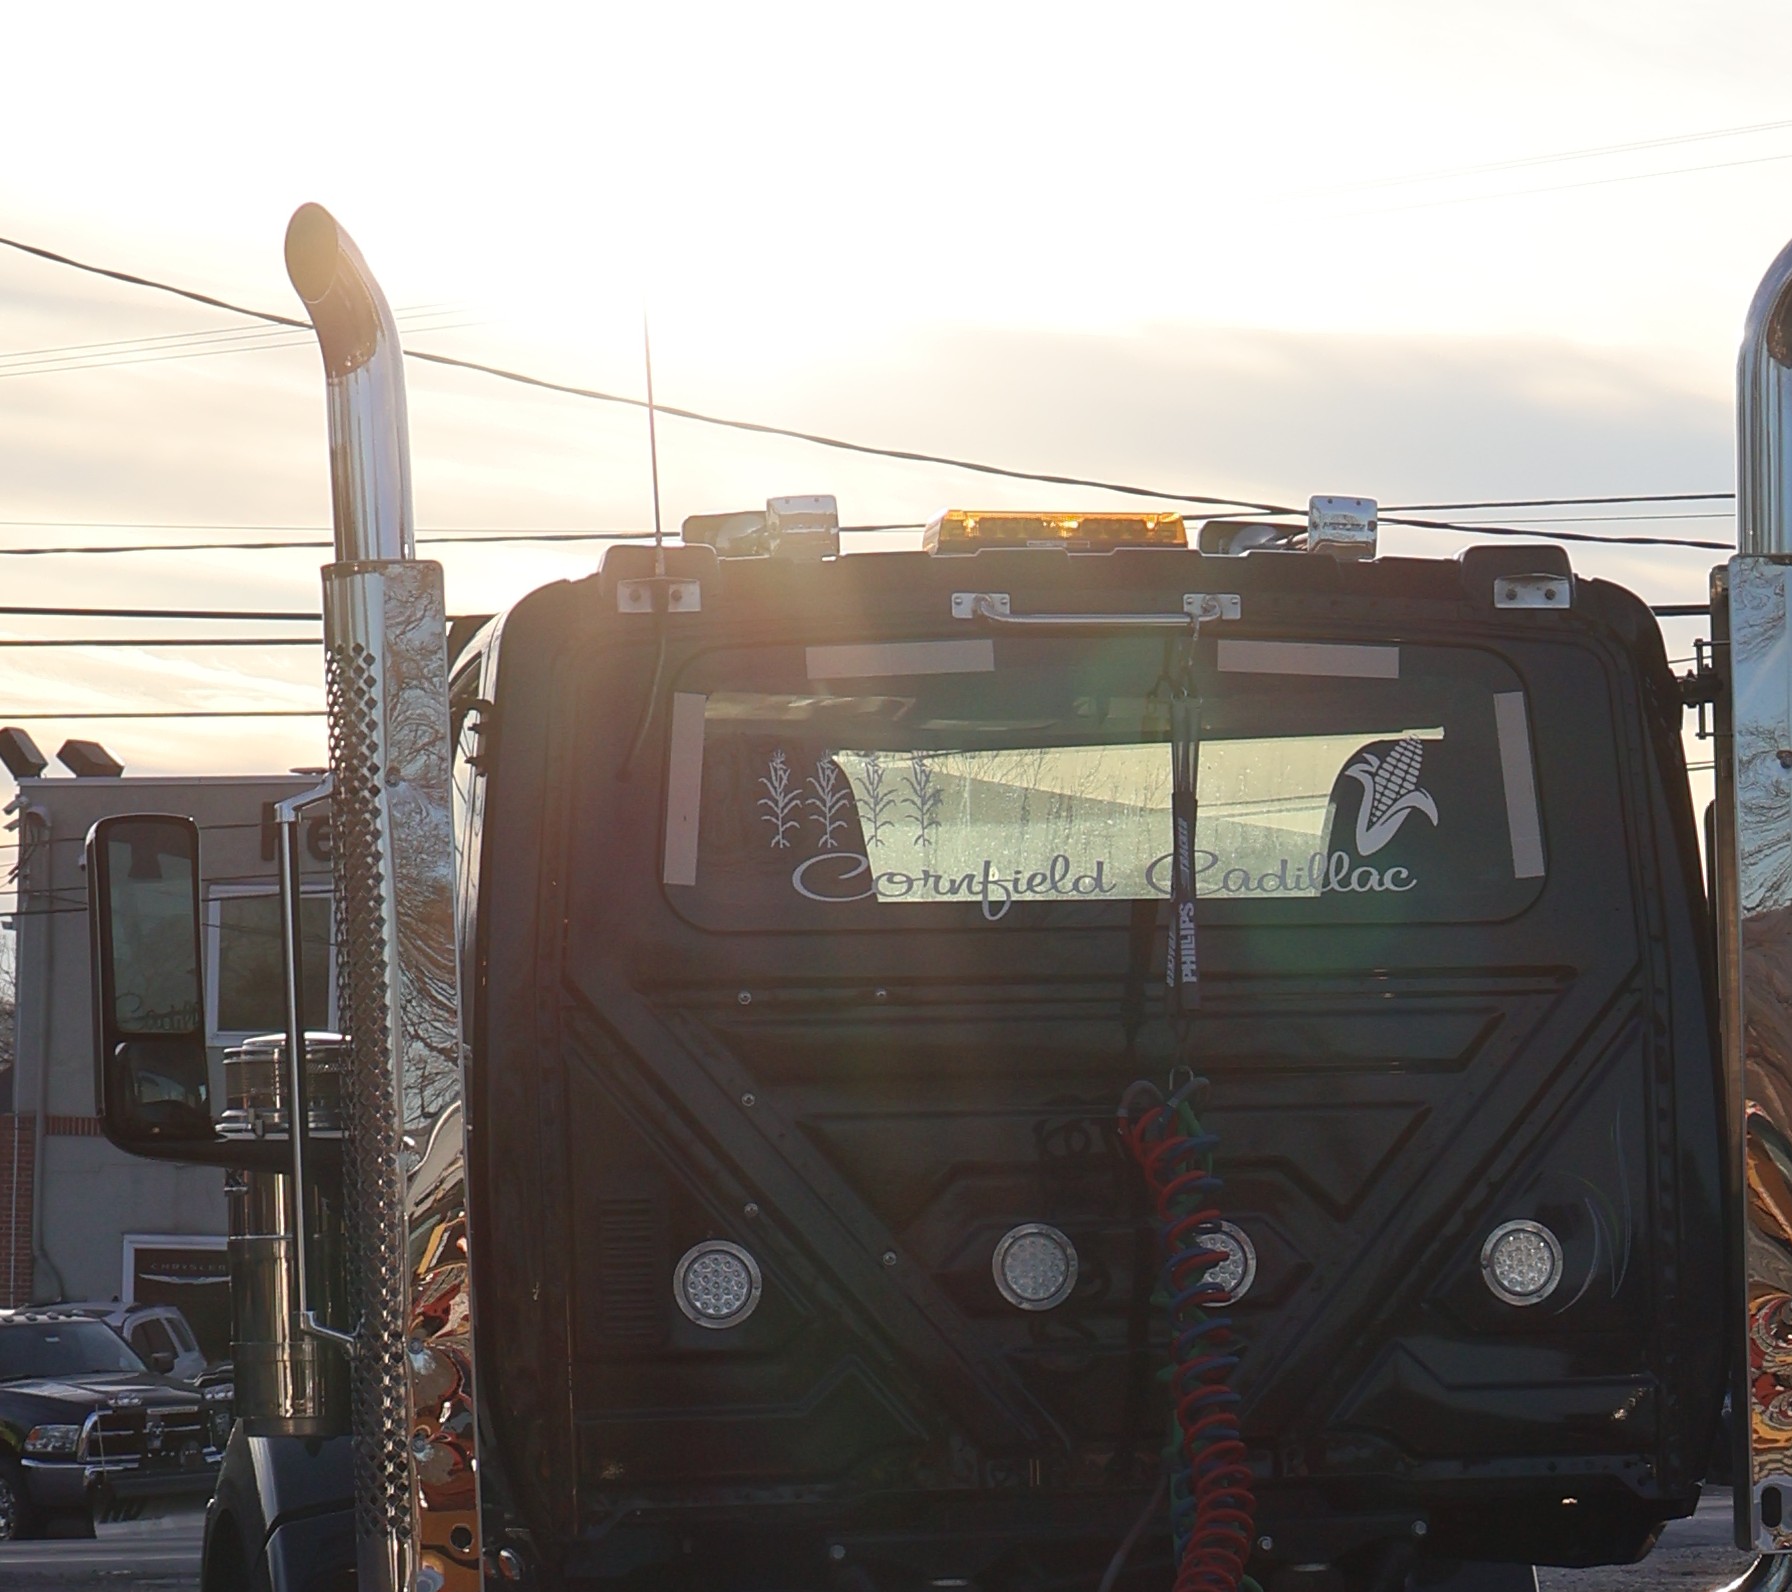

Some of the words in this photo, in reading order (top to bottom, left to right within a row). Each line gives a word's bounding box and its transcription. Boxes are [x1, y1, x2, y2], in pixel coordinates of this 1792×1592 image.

[792, 853, 1116, 921] Cornfield
[1145, 850, 1418, 895] Cadillac
[1179, 902, 1197, 983] PHILLIPS
